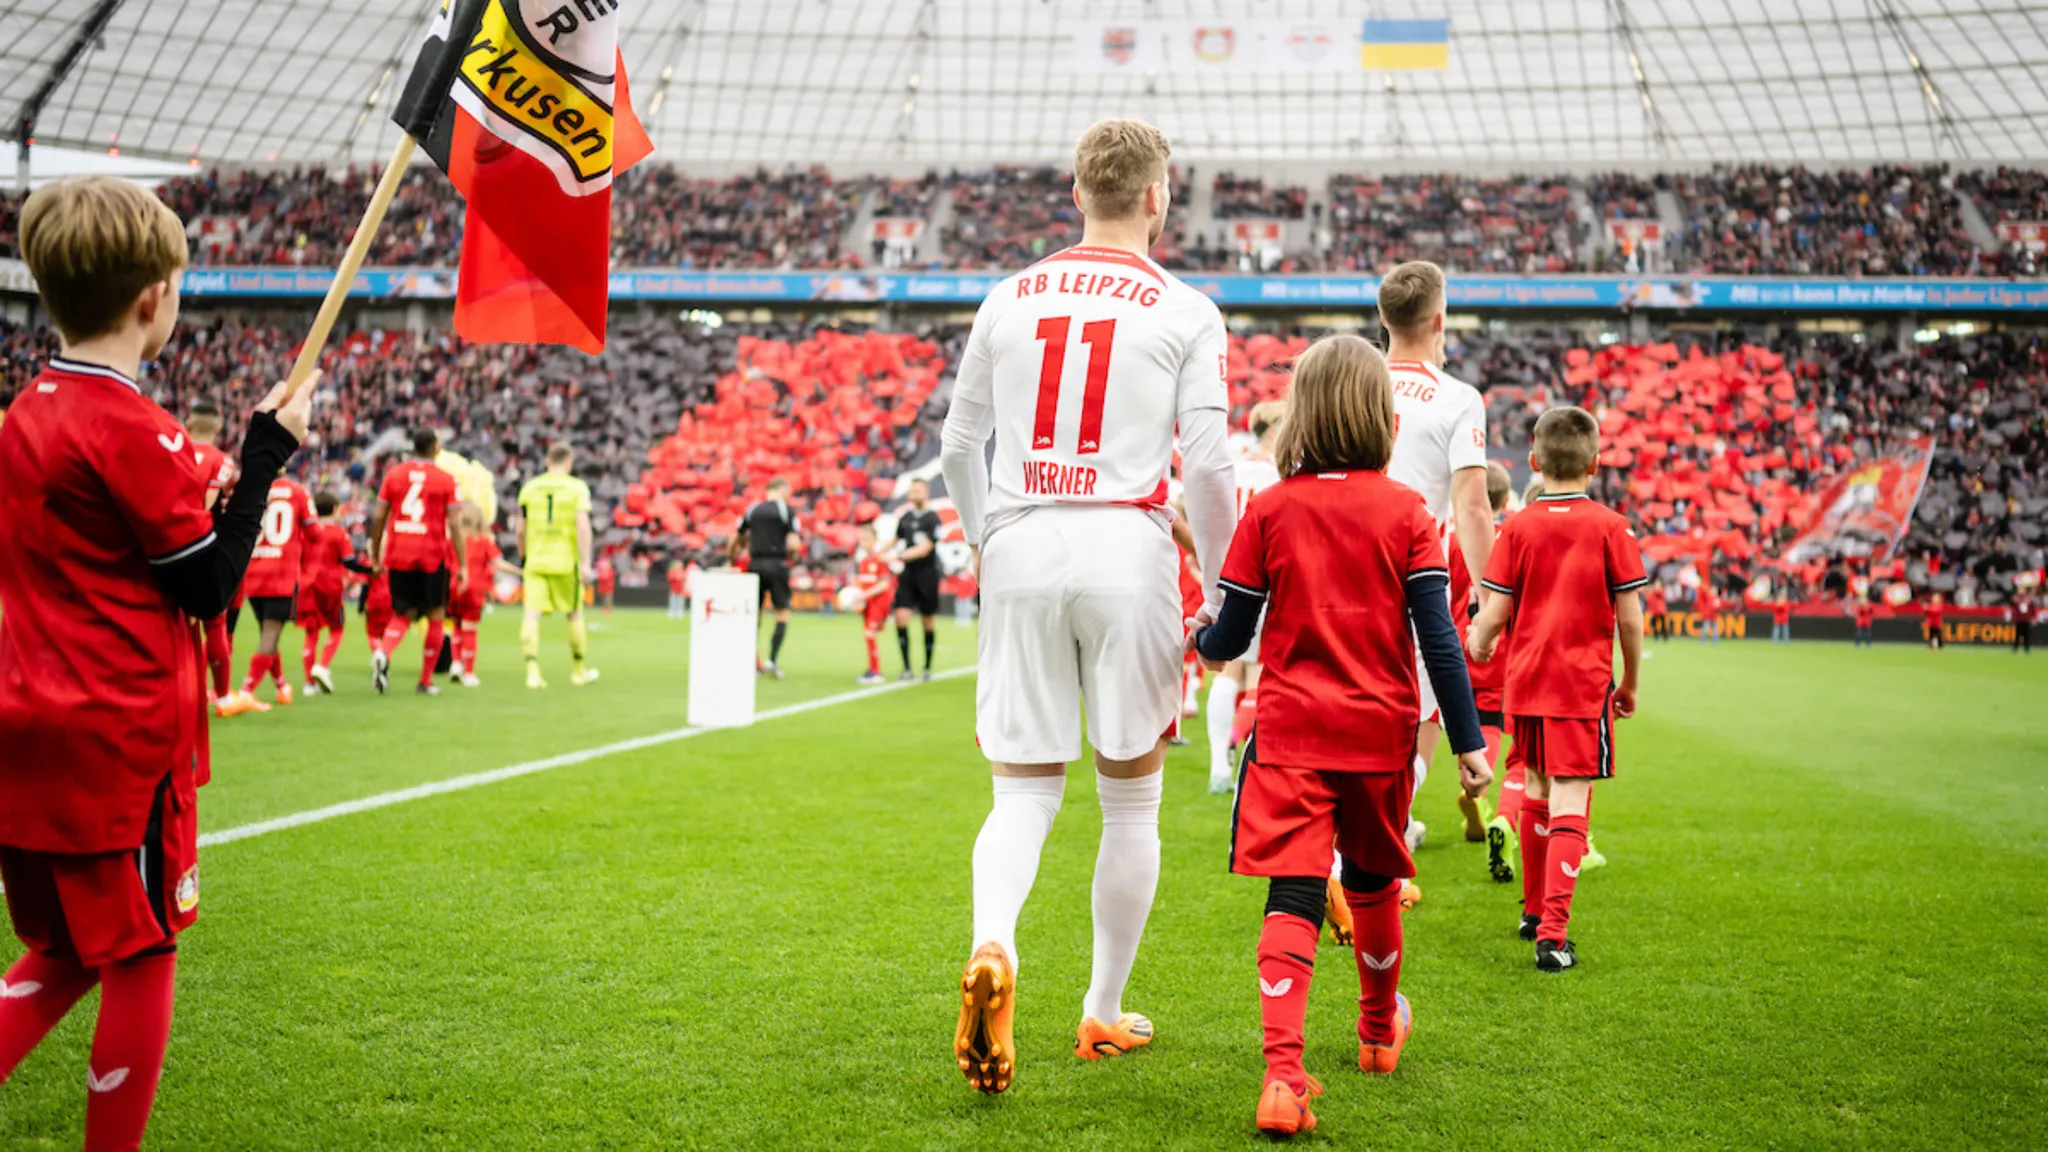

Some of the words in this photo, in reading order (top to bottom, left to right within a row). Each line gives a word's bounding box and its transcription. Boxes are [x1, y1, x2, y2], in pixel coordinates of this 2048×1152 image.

[1016, 273, 1049, 299] RB
[1058, 272, 1160, 307] LEIPZIG
[1031, 315, 1117, 455] 11
[1392, 379, 1436, 403] PZIG
[1023, 461, 1097, 495] WERNER
[401, 482, 425, 522] 4
[546, 494, 553, 525] 1
